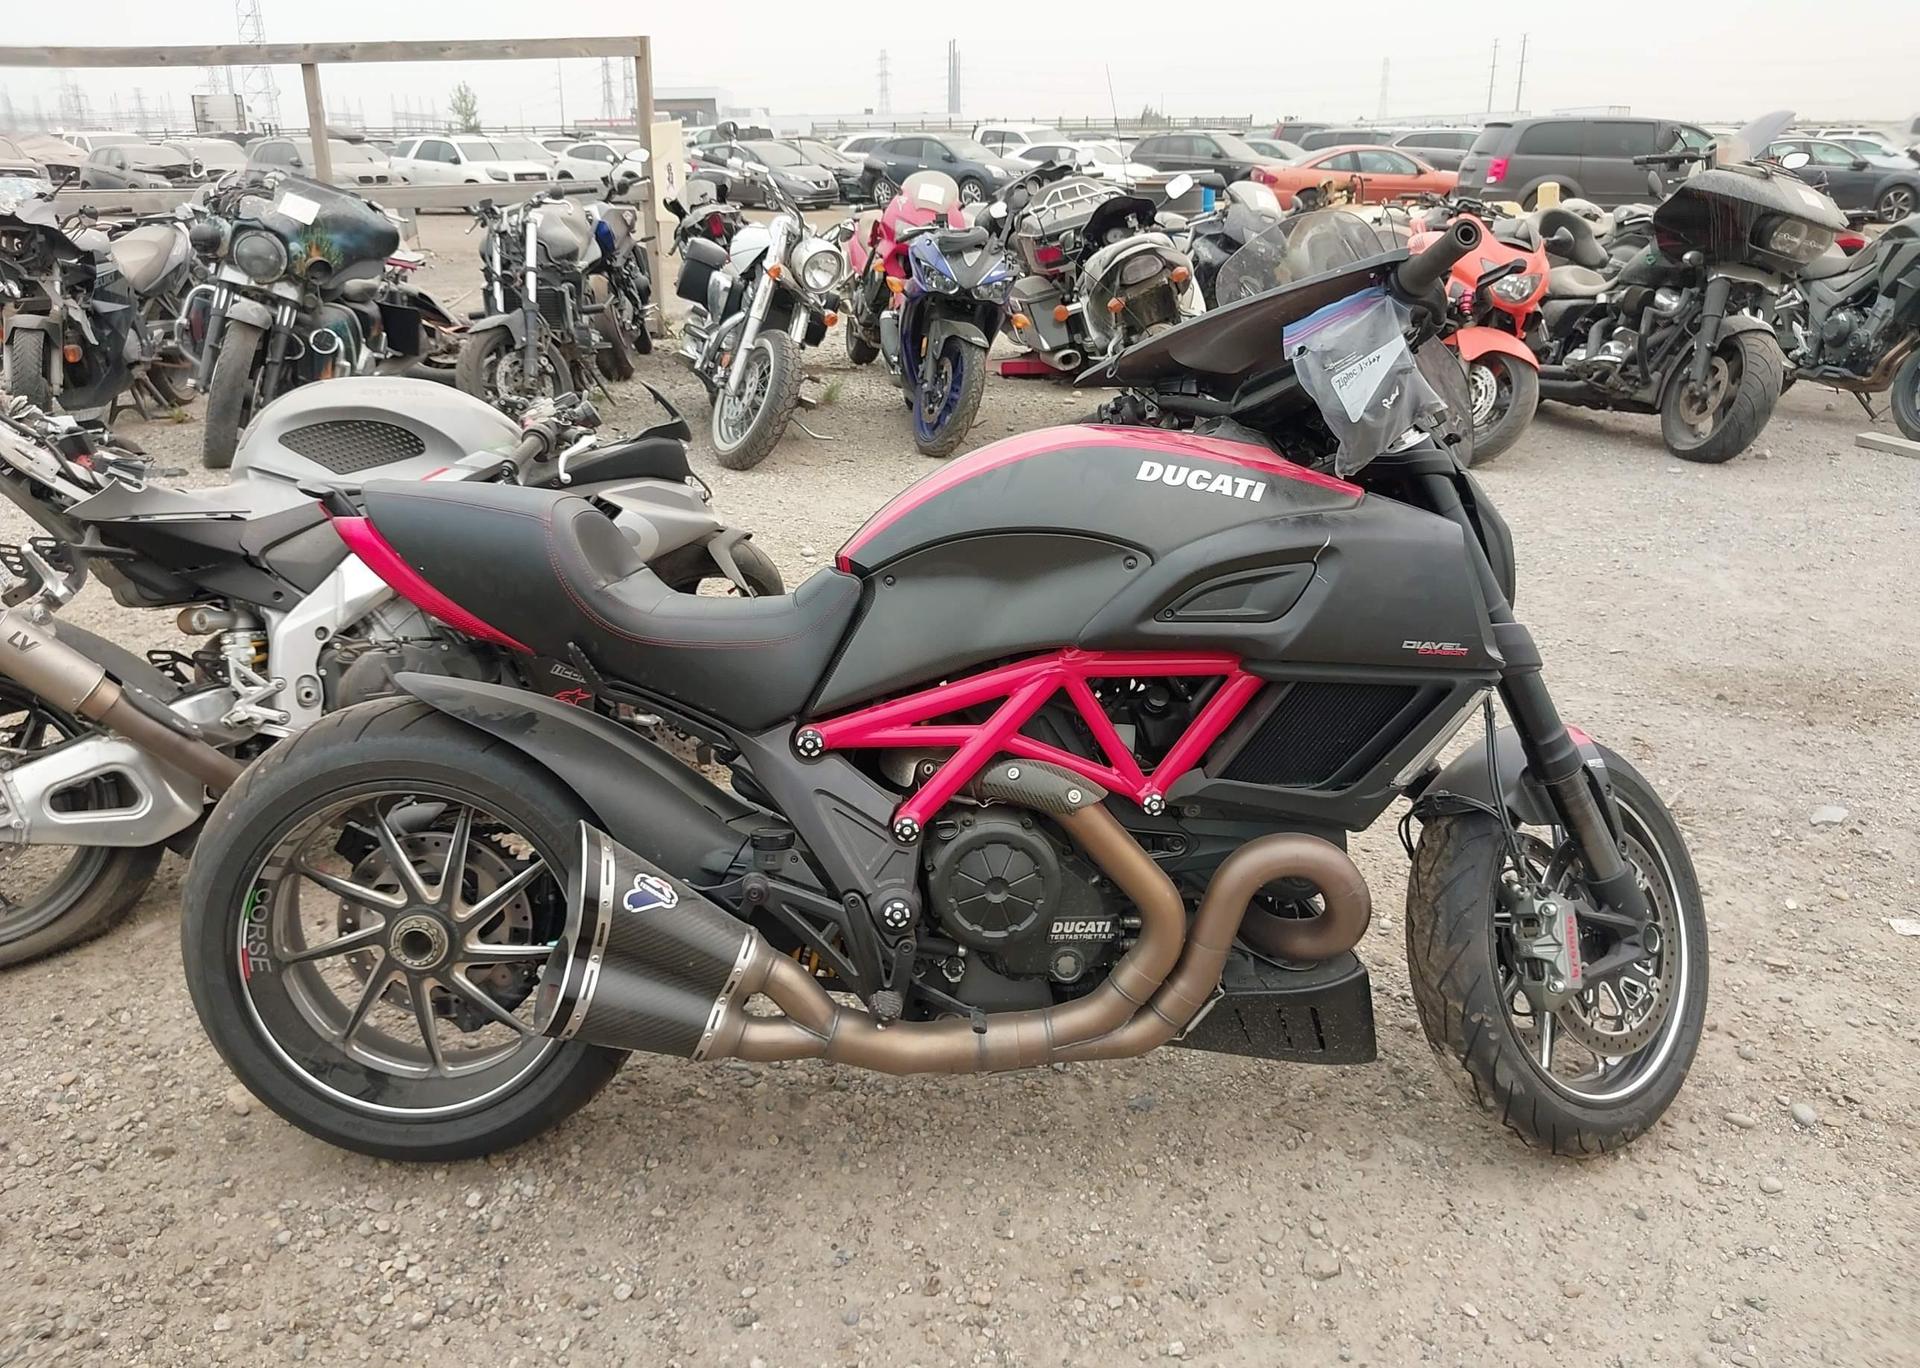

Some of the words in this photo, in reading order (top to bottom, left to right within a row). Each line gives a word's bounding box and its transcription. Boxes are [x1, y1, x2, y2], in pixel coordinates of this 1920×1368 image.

[1136, 460, 1267, 503] DUCATI
[7, 630, 40, 652] LV
[1402, 640, 1468, 651] DIAVEL
[1418, 648, 1468, 656] CARBON
[247, 887, 273, 973] CORSE
[1051, 920, 1111, 934] DUCATI
[1567, 915, 1580, 979] brembo
